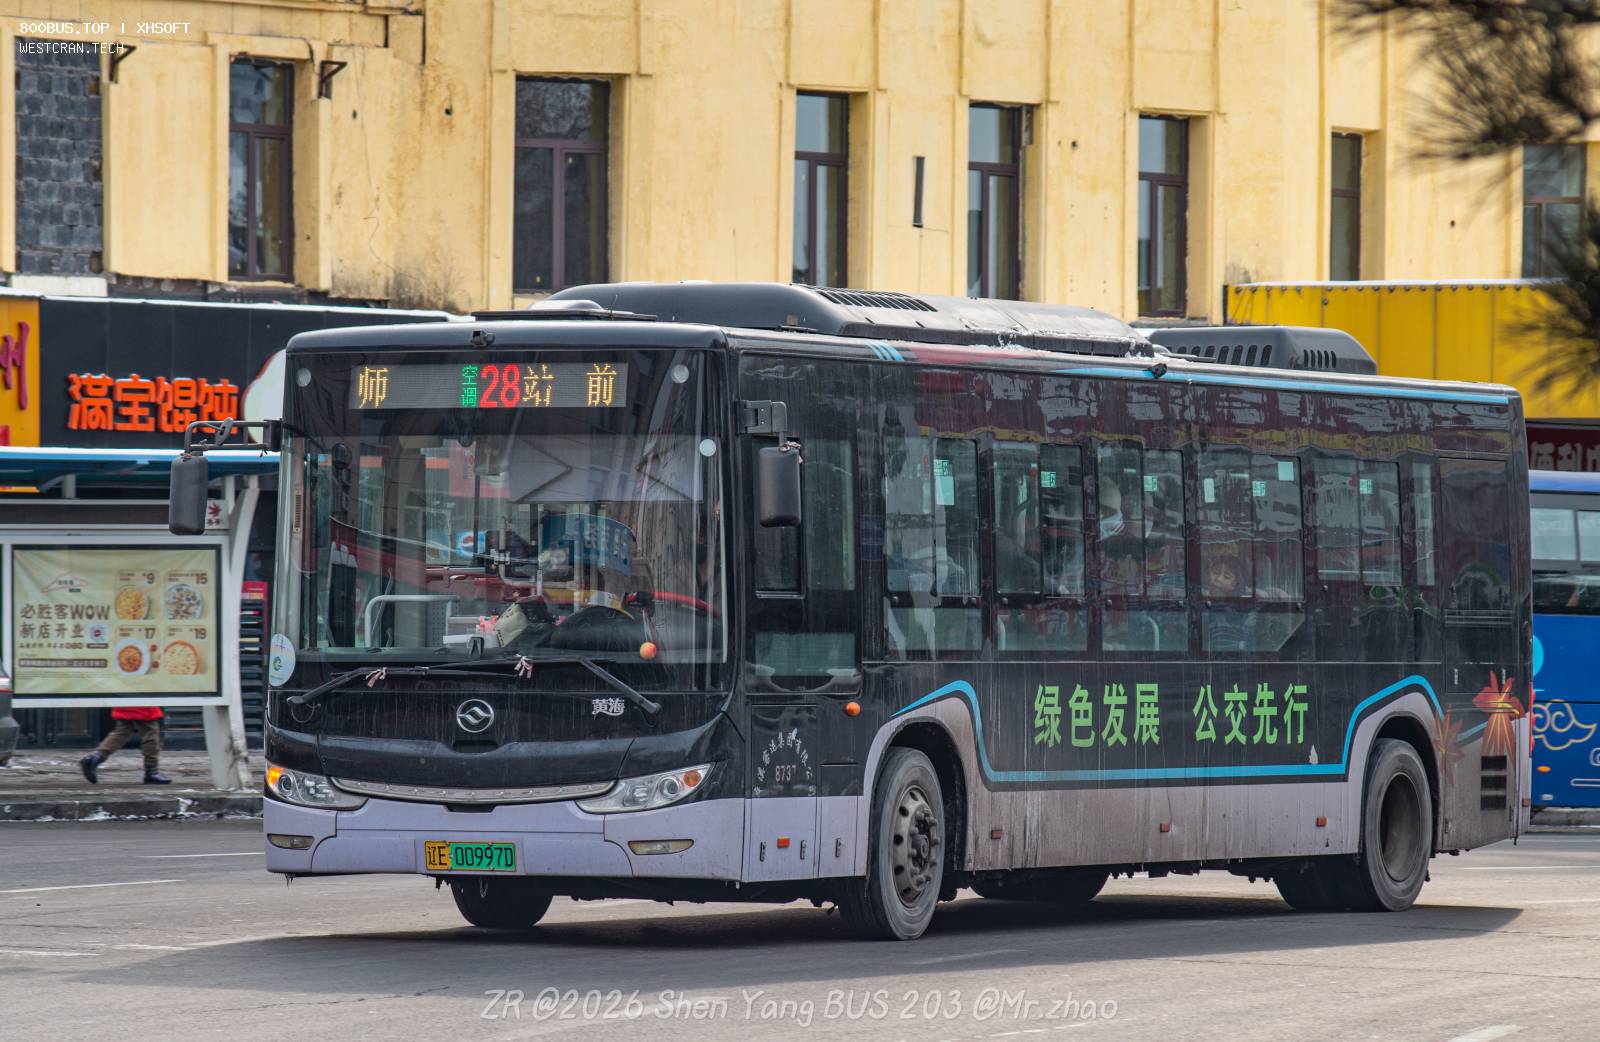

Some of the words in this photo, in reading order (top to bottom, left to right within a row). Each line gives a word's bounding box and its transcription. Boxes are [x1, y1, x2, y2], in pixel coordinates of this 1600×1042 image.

[358, 366, 389, 408] 师
[523, 364, 554, 407] 站
[587, 363, 617, 407] 前
[460, 364, 479, 408] 空调
[479, 363, 521, 408] 28
[19, 622, 84, 639] 新店开业
[144, 628, 156, 639] 17
[592, 698, 625, 716] 黄海
[1034, 683, 1160, 748] 绿色发展
[1193, 683, 1308, 745] 公交先行
